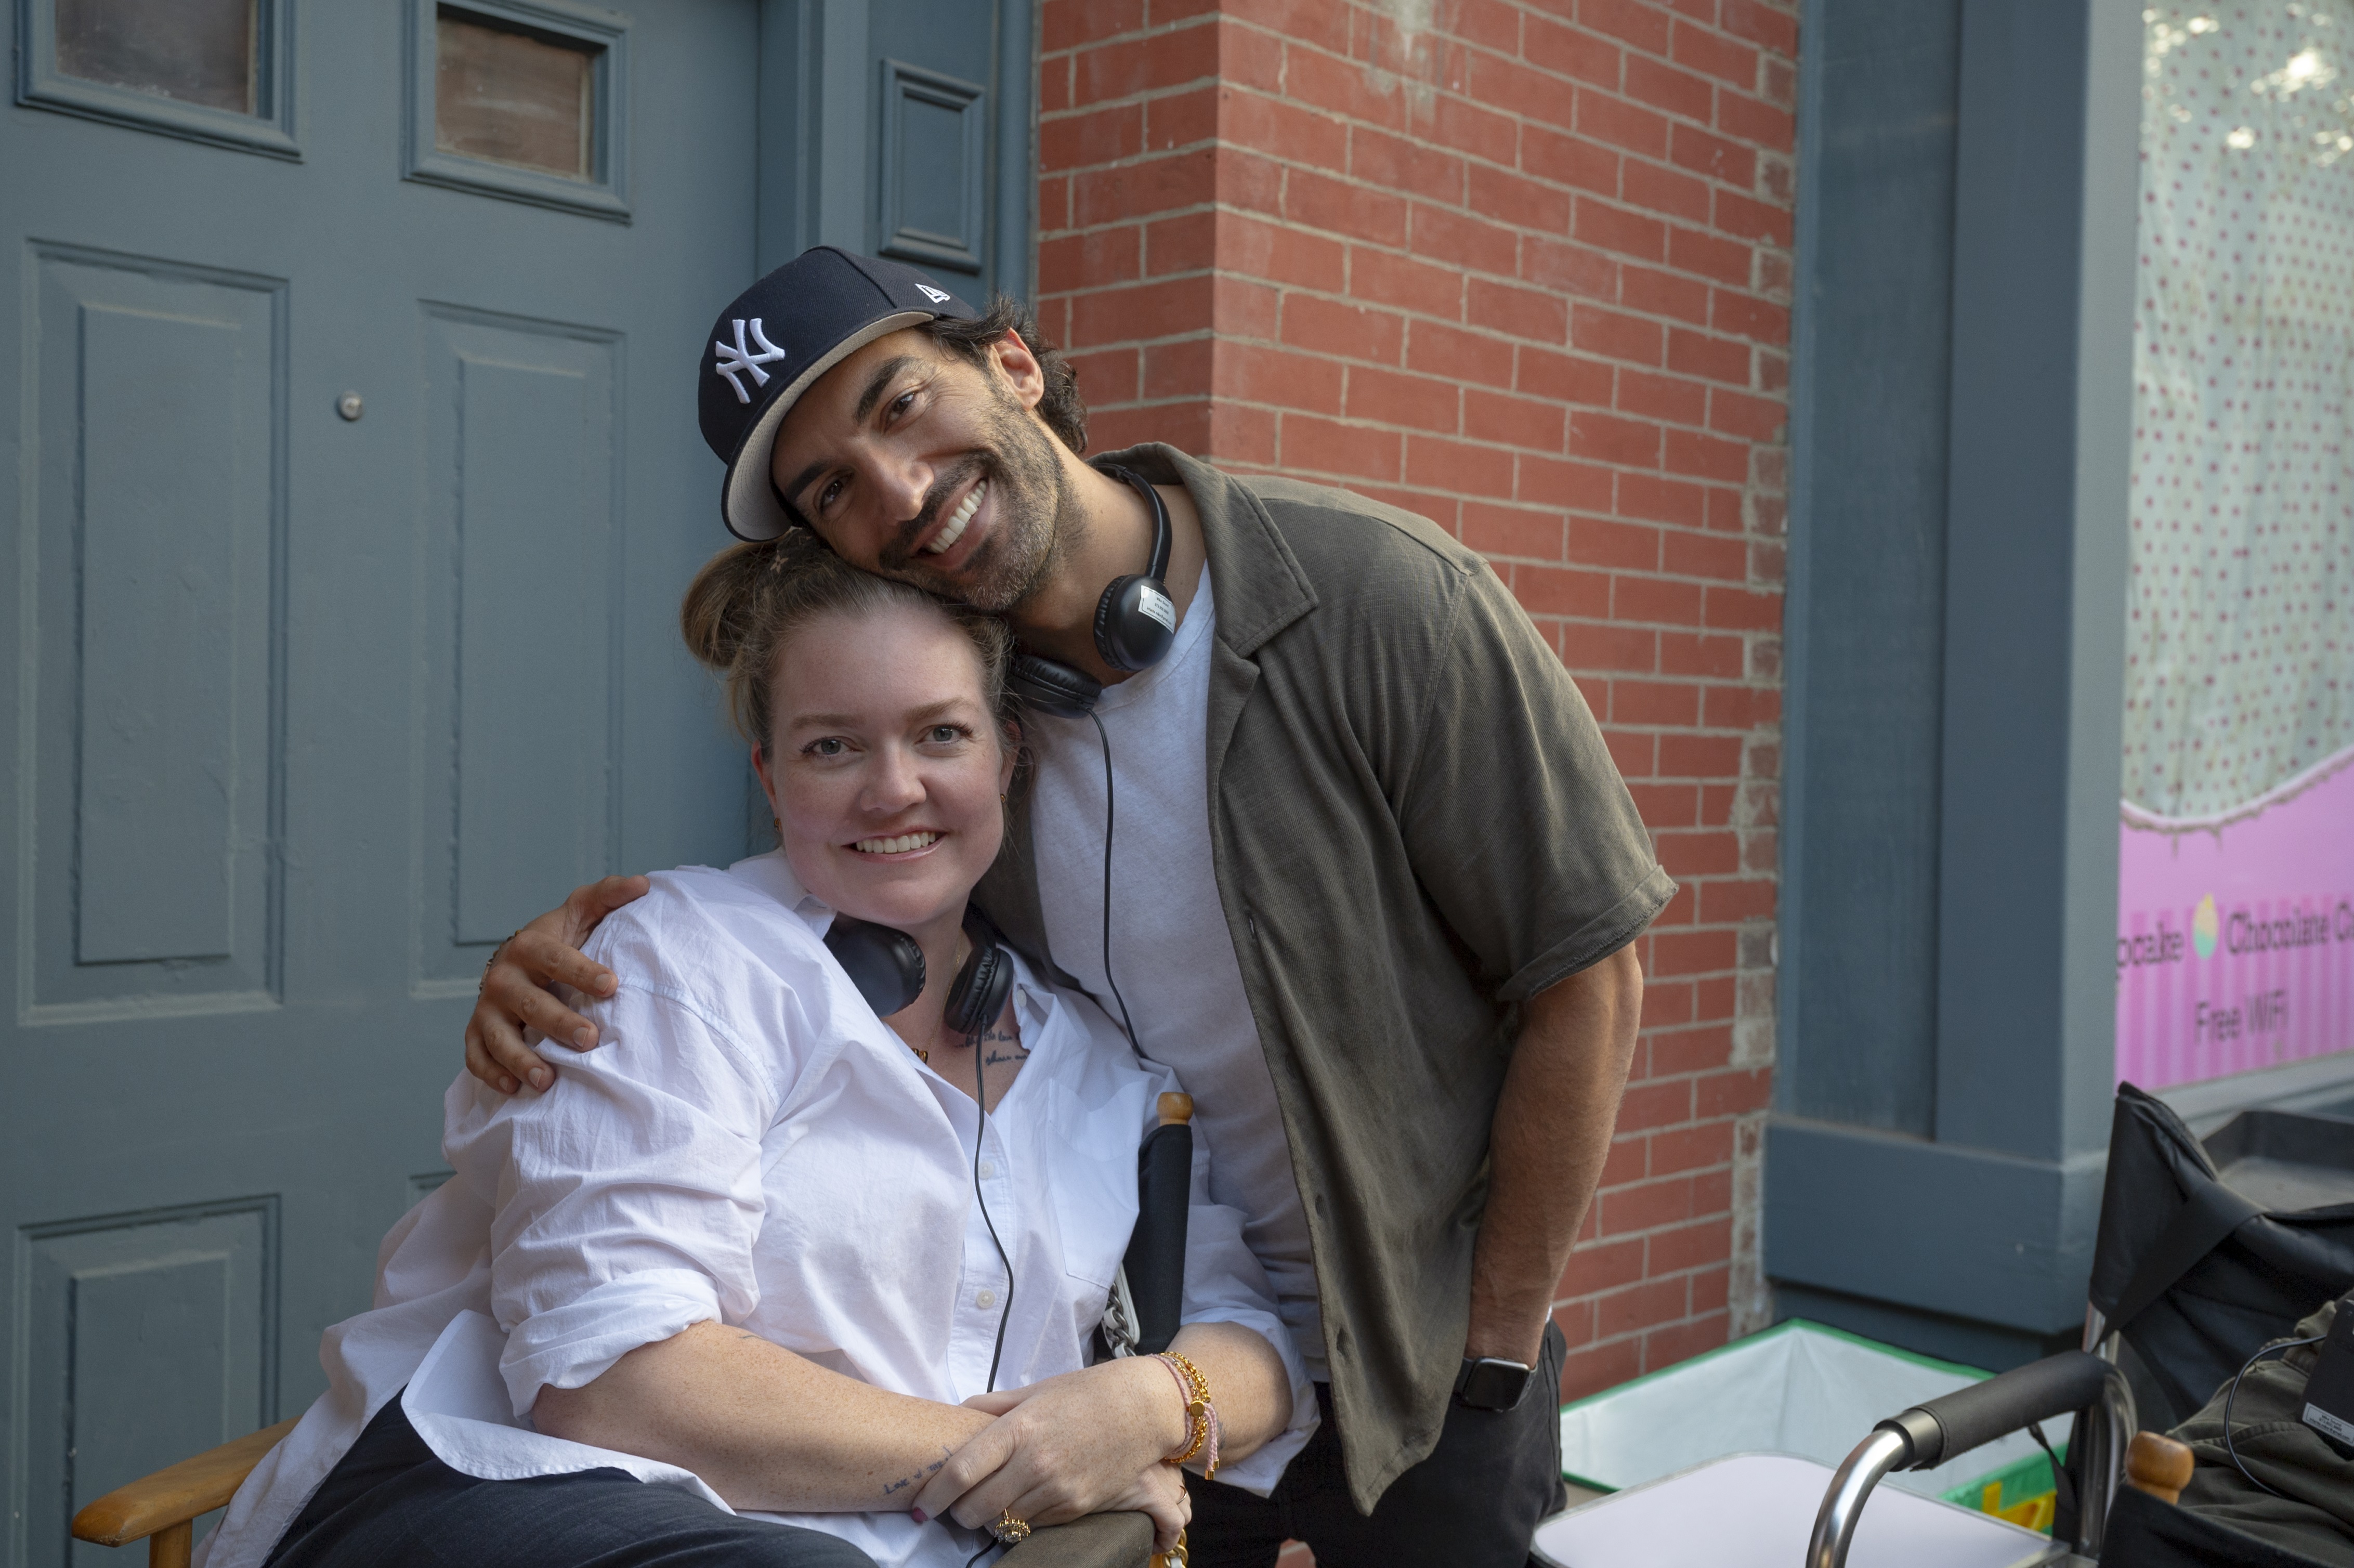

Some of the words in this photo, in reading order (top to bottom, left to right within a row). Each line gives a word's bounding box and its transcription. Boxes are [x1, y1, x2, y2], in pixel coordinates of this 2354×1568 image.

[715, 318, 786, 404] NY
[2226, 907, 2330, 956] Chocolate
[2194, 999, 2241, 1045] Free
[2245, 989, 2288, 1035] WiFi
